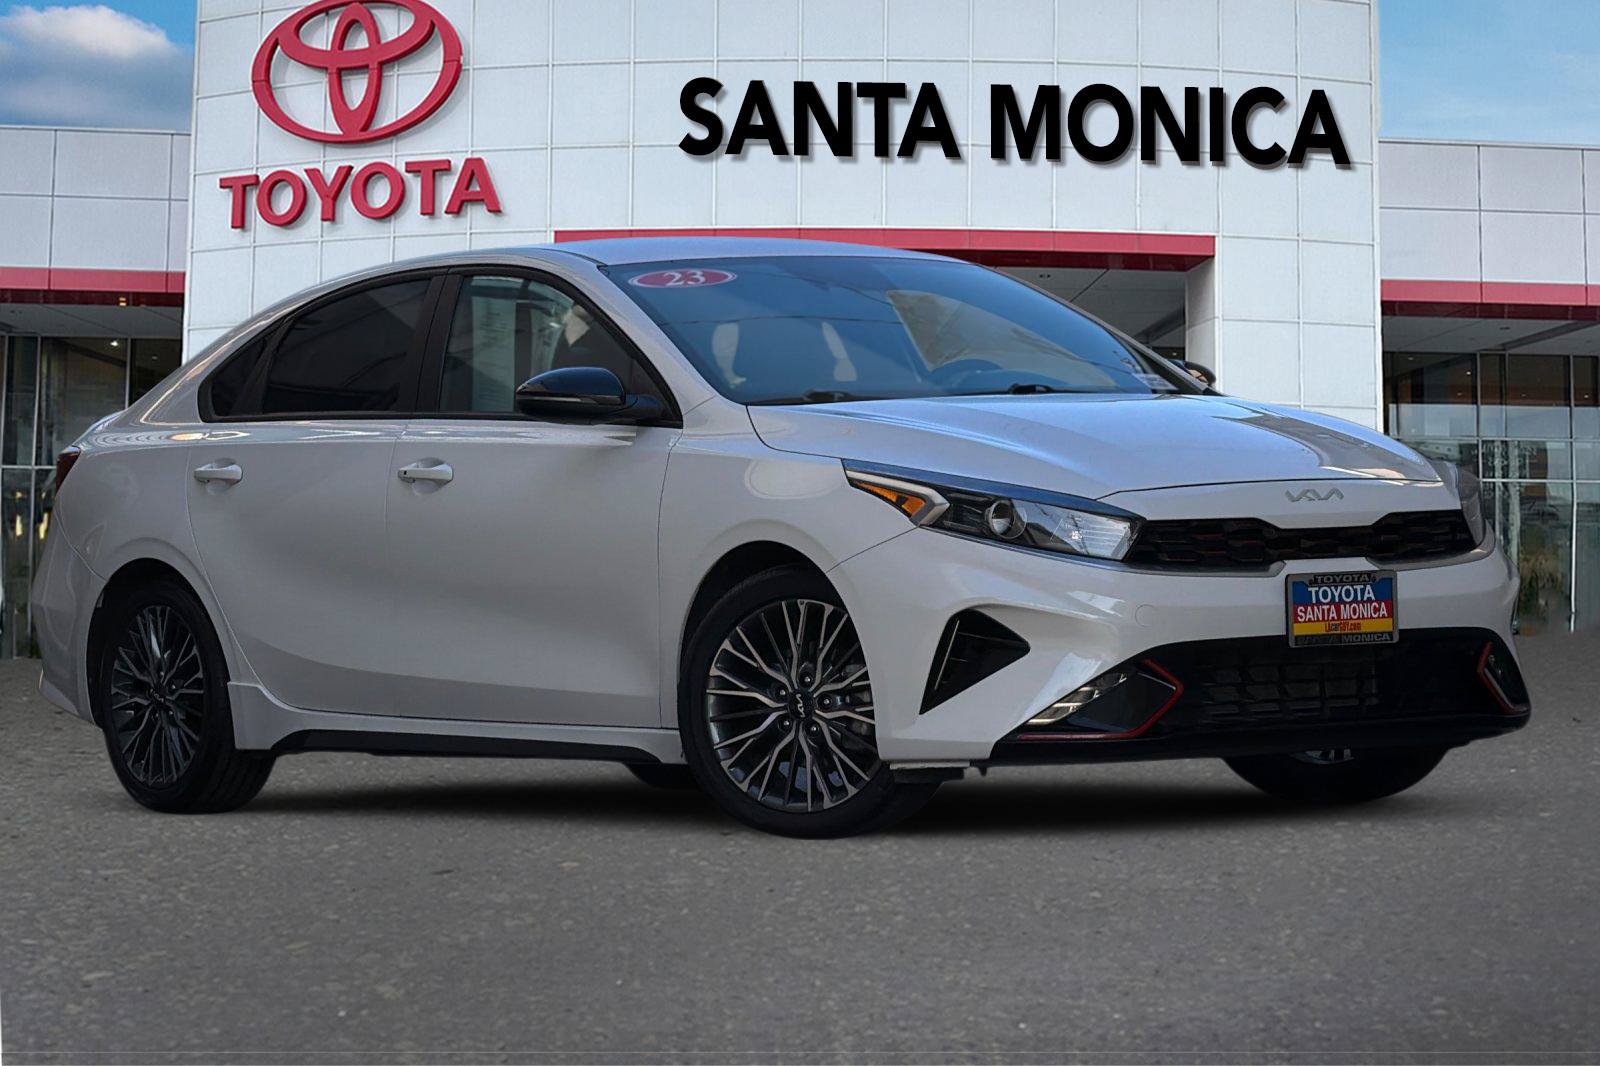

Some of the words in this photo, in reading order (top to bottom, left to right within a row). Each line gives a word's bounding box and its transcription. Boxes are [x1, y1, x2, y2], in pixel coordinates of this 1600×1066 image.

[679, 78, 960, 157] SANTA
[991, 84, 1350, 168] MONICA
[220, 157, 500, 228] TOYOTA
[663, 269, 706, 287] 23
[1315, 573, 1370, 585] TOYOTA
[1307, 584, 1376, 604] TOYOTA
[1297, 605, 1338, 622] SANTA
[1340, 602, 1388, 620] MONICA
[1341, 632, 1391, 643] MONICA
